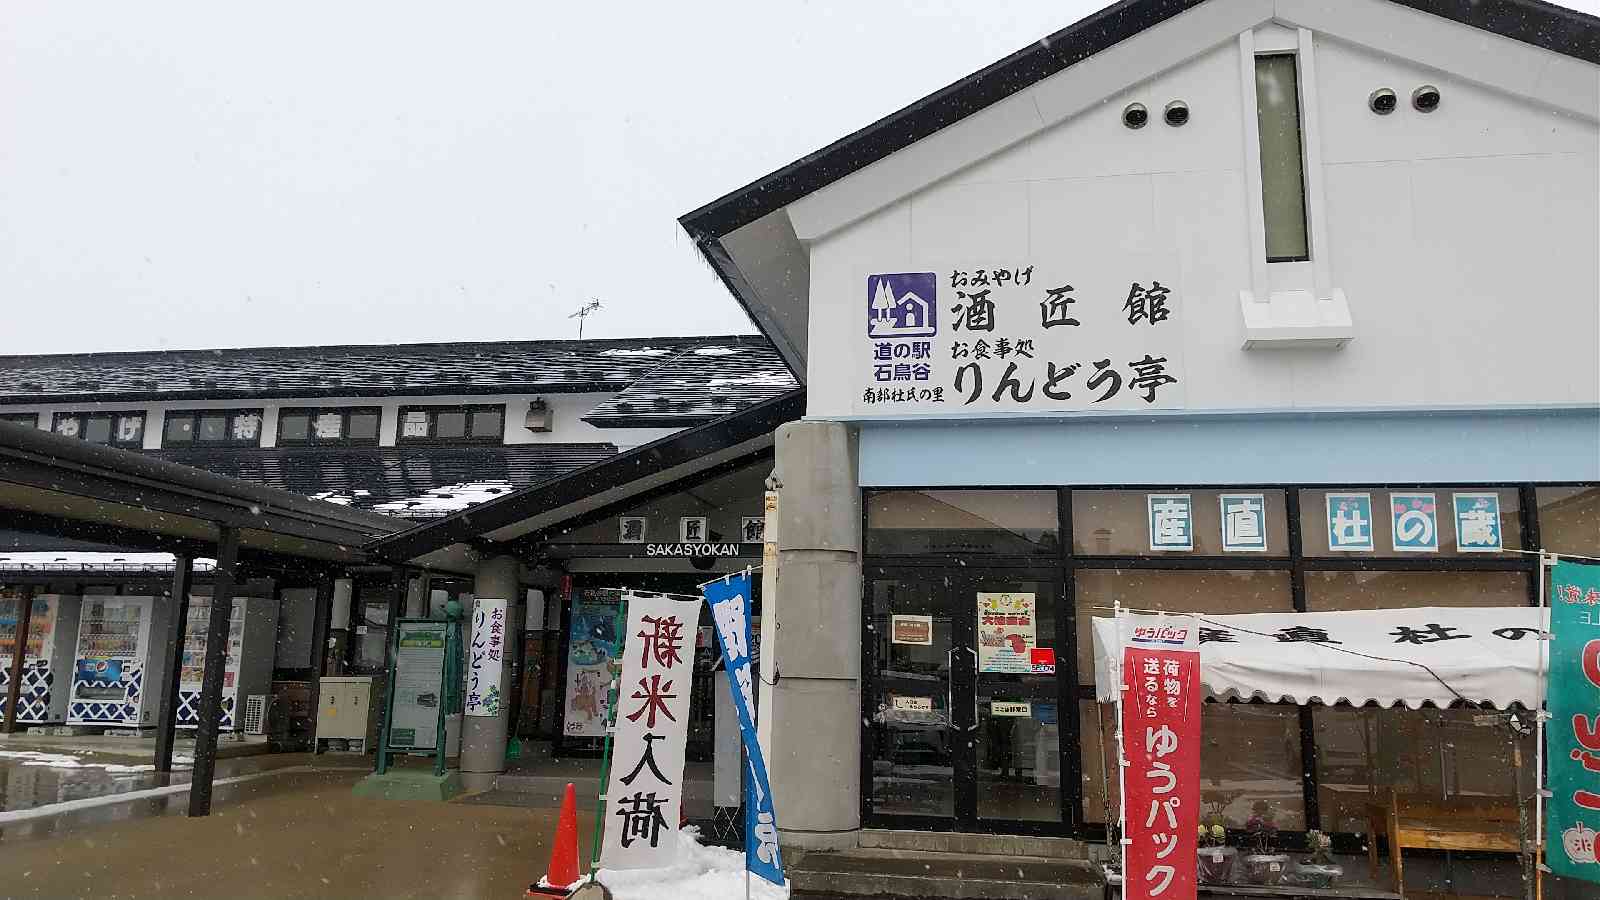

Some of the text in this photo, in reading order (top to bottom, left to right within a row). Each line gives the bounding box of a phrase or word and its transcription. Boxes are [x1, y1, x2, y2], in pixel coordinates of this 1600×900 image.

[951, 265, 1033, 288] おみやげ
[951, 281, 1171, 332] 酒匠館
[874, 341, 931, 361] 道の駅
[874, 362, 931, 382] 石鳥谷
[951, 338, 1034, 360] お食事処
[953, 354, 1178, 405] りんどう亭
[1153, 499, 1263, 545] 産直
[646, 543, 739, 556] SAKASYOKAN
[488, 607, 503, 662] お食事処
[1134, 626, 1188, 640] ゆうパック
[466, 610, 486, 712] りんどう亭
[1163, 659, 1181, 708] 荷物を
[1143, 657, 1160, 718] 送るなら
[1145, 724, 1181, 897] ゆうパック
